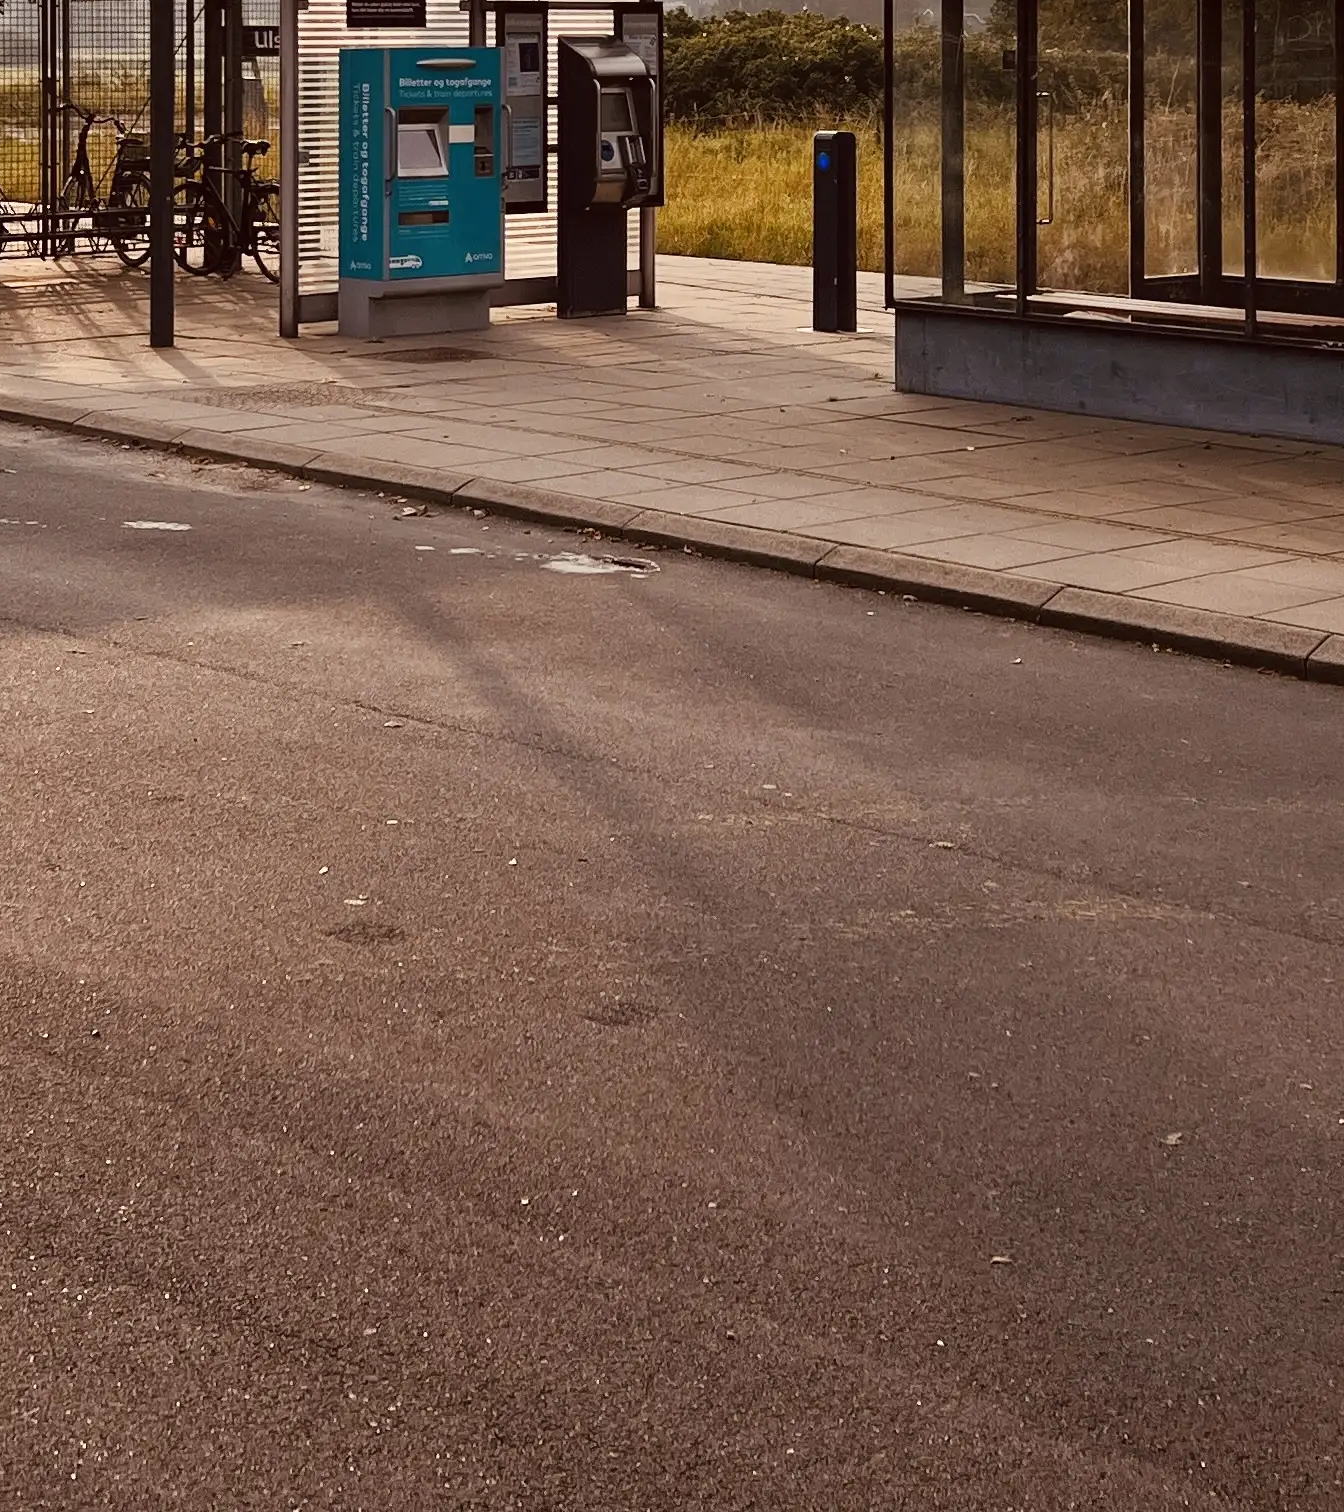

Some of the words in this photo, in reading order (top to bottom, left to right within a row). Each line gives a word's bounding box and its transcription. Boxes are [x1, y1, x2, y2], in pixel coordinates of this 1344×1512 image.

[399, 77, 432, 87] Billetter
[433, 78, 444, 89] og
[445, 76, 492, 88] togafgange
[399, 89, 425, 99] Tickets
[426, 89, 433, 98] &
[361, 83, 370, 139] Billetter
[360, 141, 369, 159] og
[360, 162, 371, 241] togafgange
